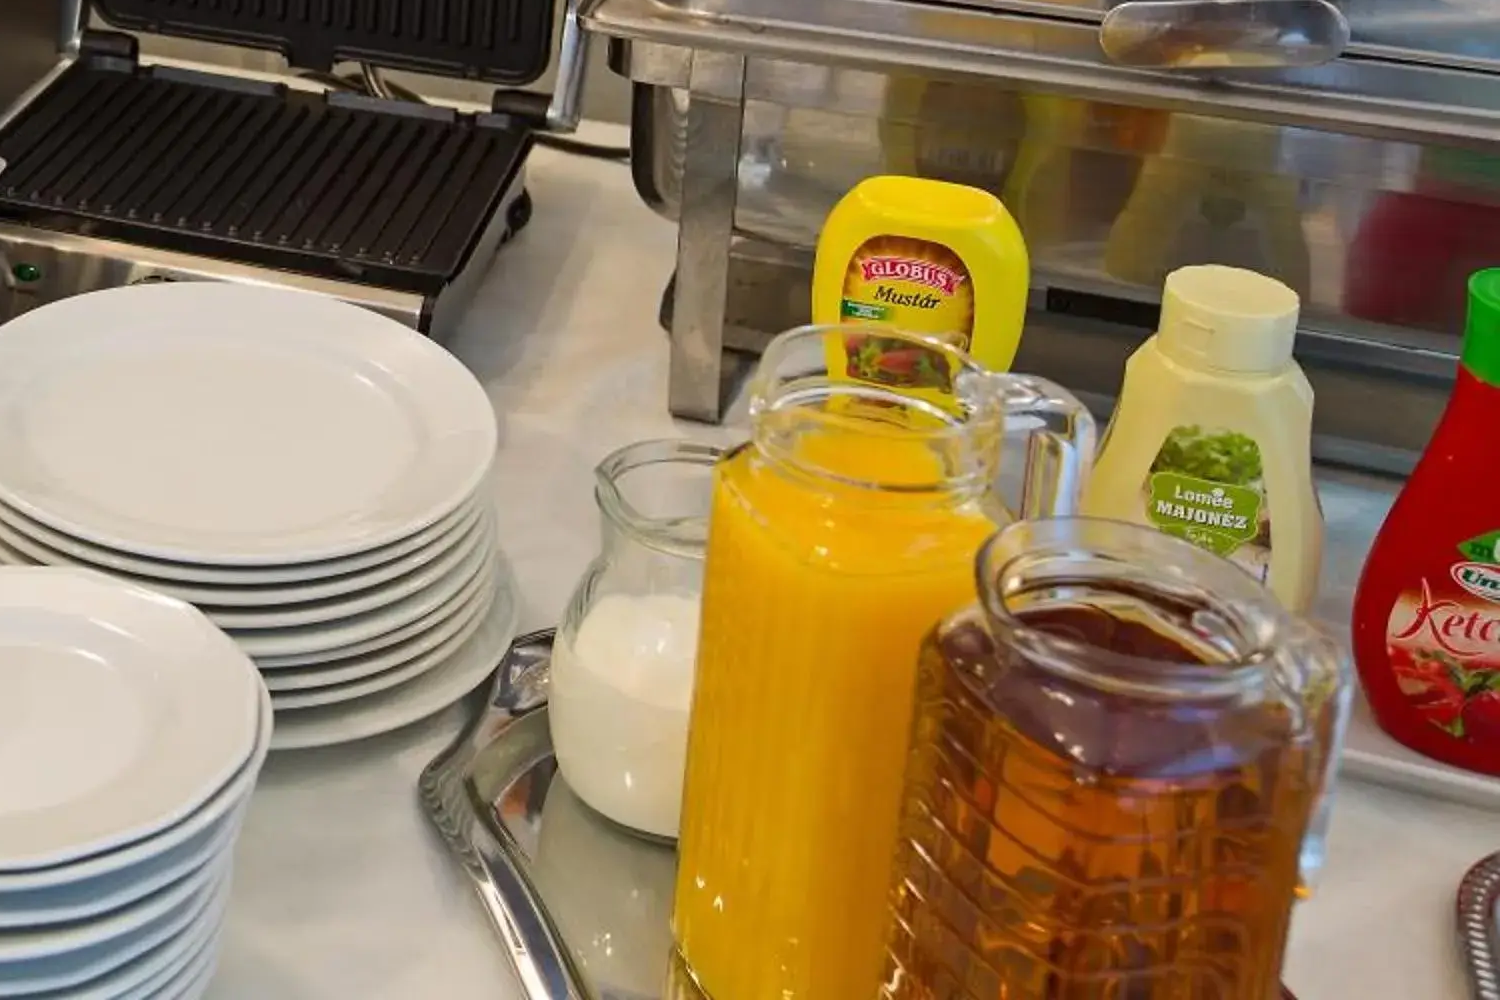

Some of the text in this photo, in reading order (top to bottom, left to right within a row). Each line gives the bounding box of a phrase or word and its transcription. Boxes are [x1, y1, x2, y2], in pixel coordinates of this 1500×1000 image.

[871, 261, 949, 288] GLOBUS
[873, 284, 941, 310] Mustár
[1156, 499, 1249, 530] MAJONÉZ
